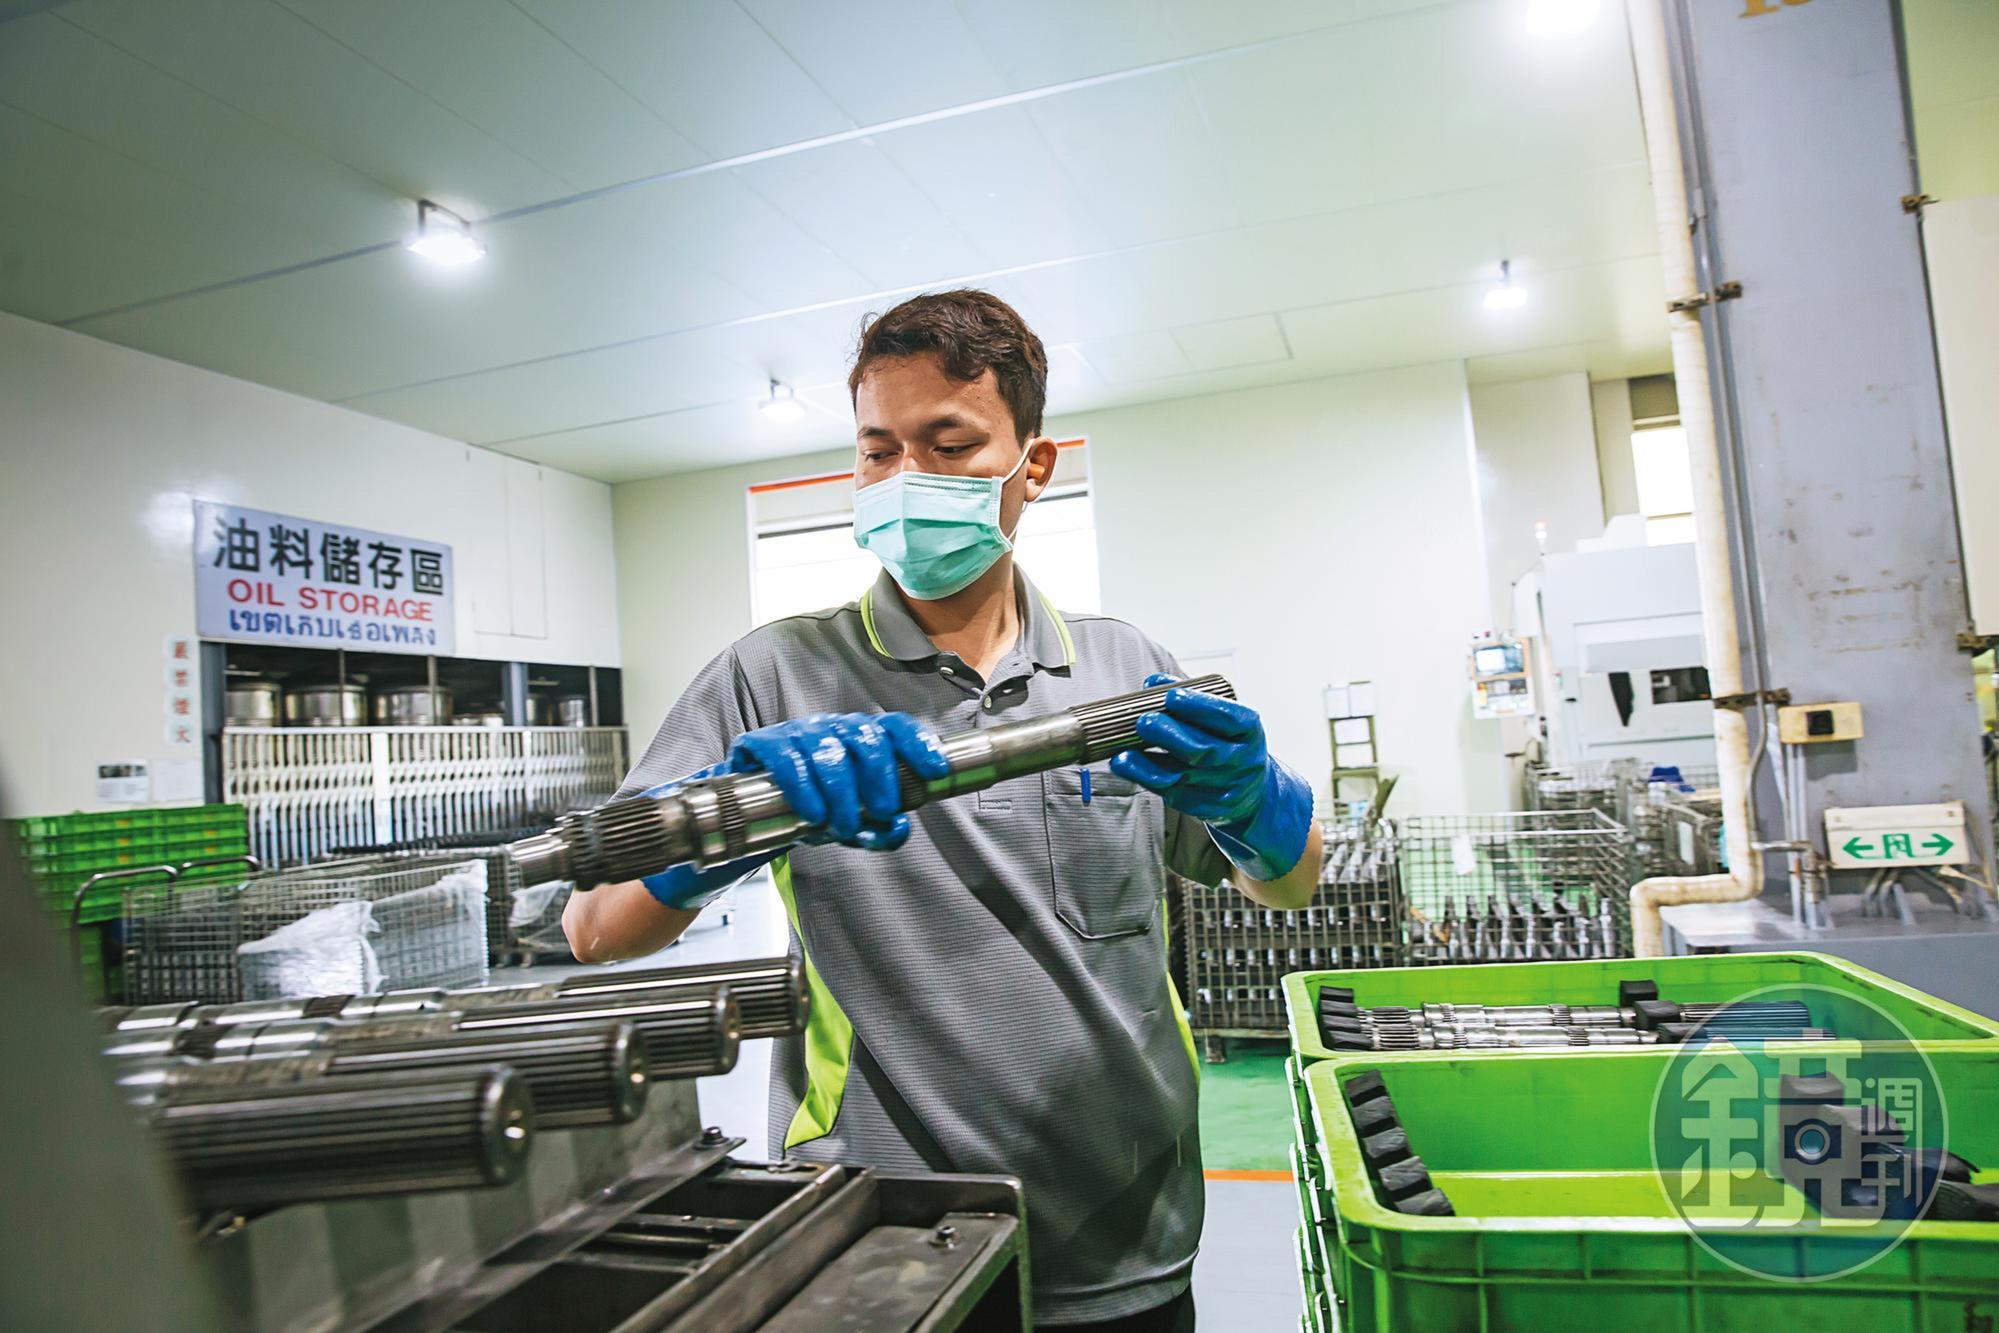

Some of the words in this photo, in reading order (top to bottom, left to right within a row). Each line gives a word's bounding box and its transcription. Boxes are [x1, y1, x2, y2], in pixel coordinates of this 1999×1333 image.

[213, 517, 443, 596] 油料儲存區
[227, 578, 285, 607] OIL
[298, 586, 433, 622] STORAGE
